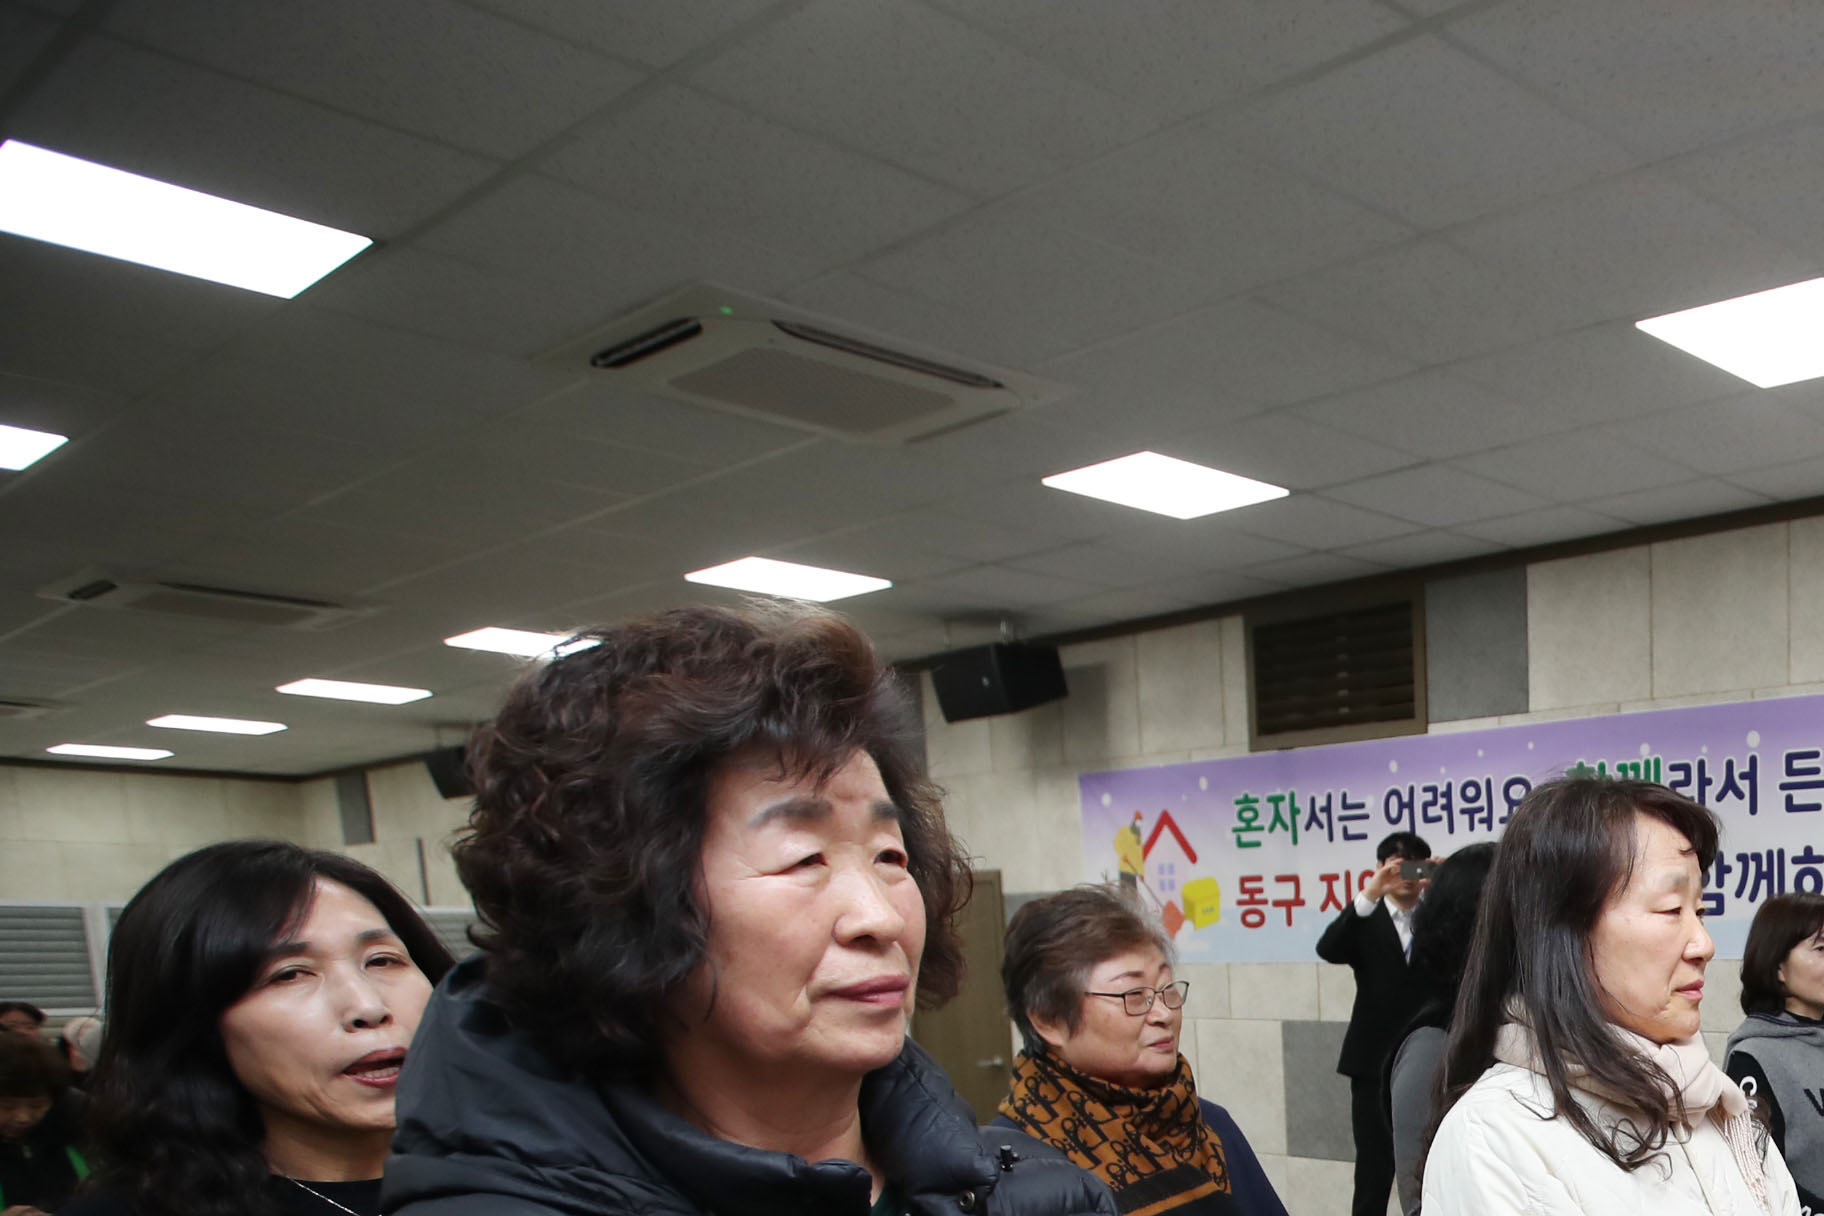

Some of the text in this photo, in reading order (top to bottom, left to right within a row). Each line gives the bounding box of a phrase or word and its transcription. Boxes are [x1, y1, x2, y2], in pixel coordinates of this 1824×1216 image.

[1231, 790, 1370, 848] 혼자서는
[1383, 776, 1533, 834] 어려워요
[1566, 755, 1758, 816] 라서
[1236, 873, 1306, 929] 동구
